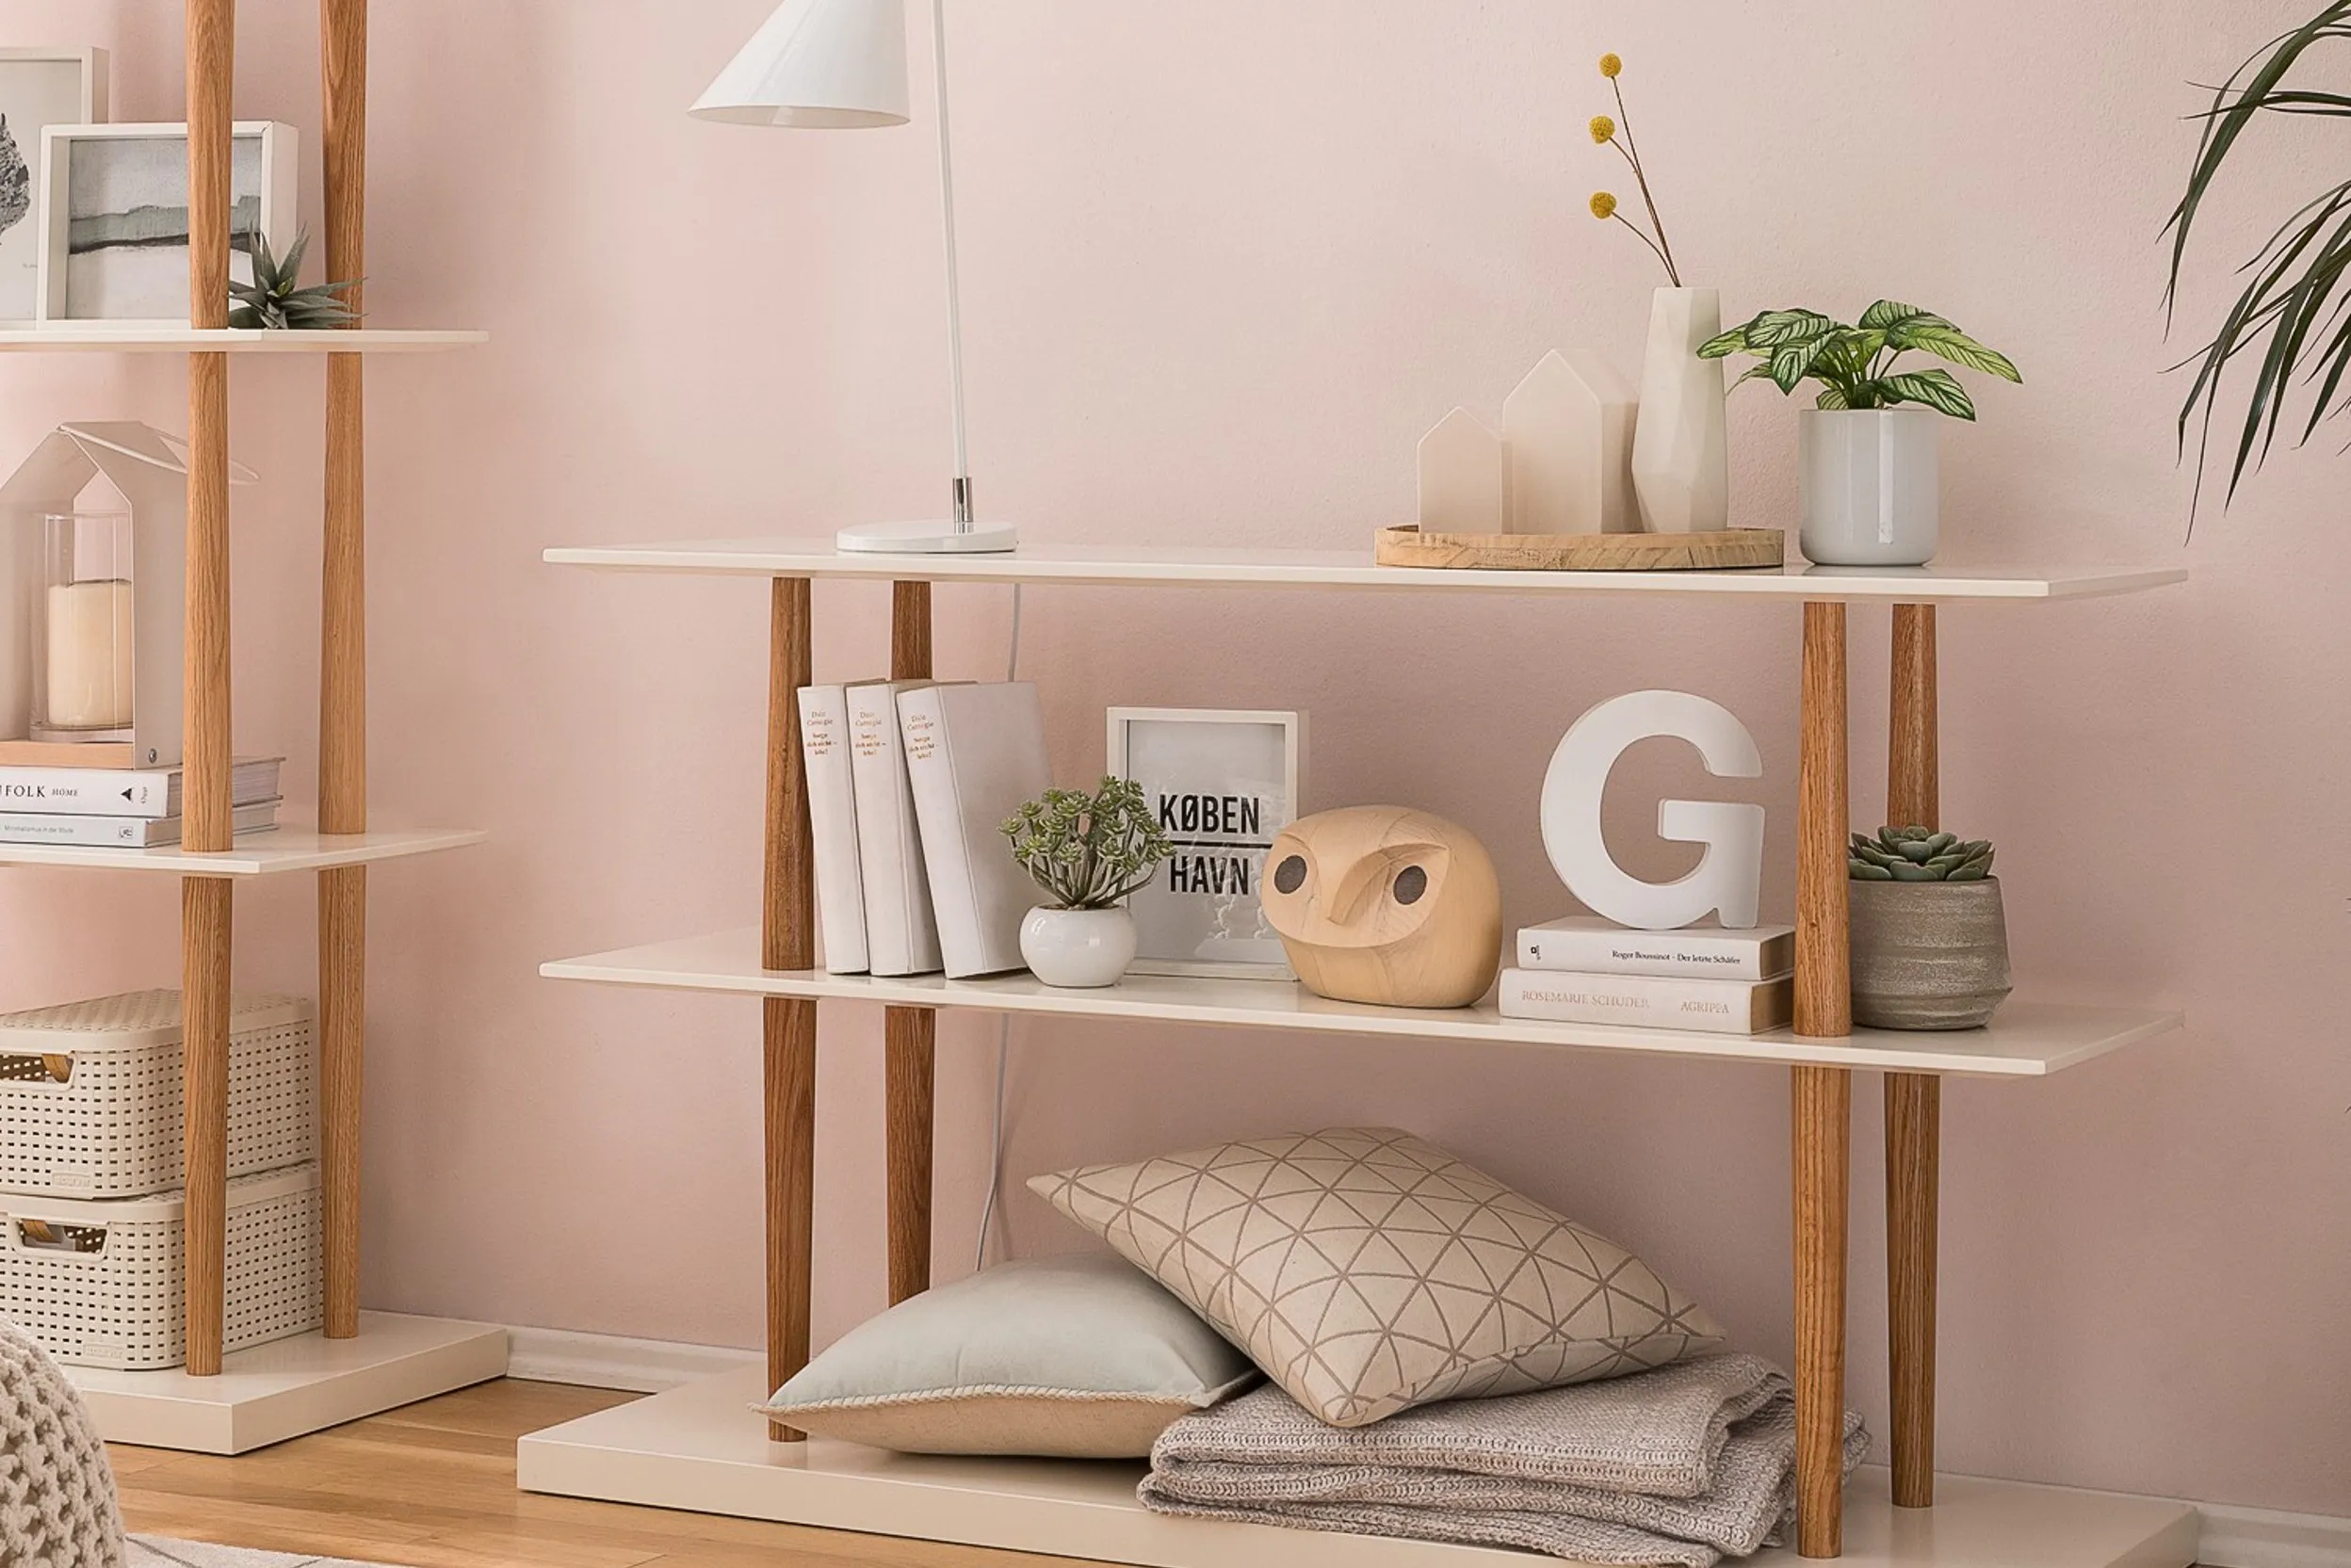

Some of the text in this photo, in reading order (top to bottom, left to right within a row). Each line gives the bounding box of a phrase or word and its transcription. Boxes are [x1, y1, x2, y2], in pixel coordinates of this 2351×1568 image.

[0, 784, 77, 798] FOLK HOME
[1159, 794, 1260, 835] KØBEN
[1540, 689, 1766, 929] G
[1169, 855, 1249, 896] HAVN
[1612, 950, 1634, 961] Roger
[1634, 951, 1670, 961] Boussinot
[1677, 953, 1691, 962] Der
[1692, 954, 1711, 963] letzte
[1521, 990, 1588, 1005] ROSEMARIE
[1680, 1000, 1730, 1014] AGRIPPA
